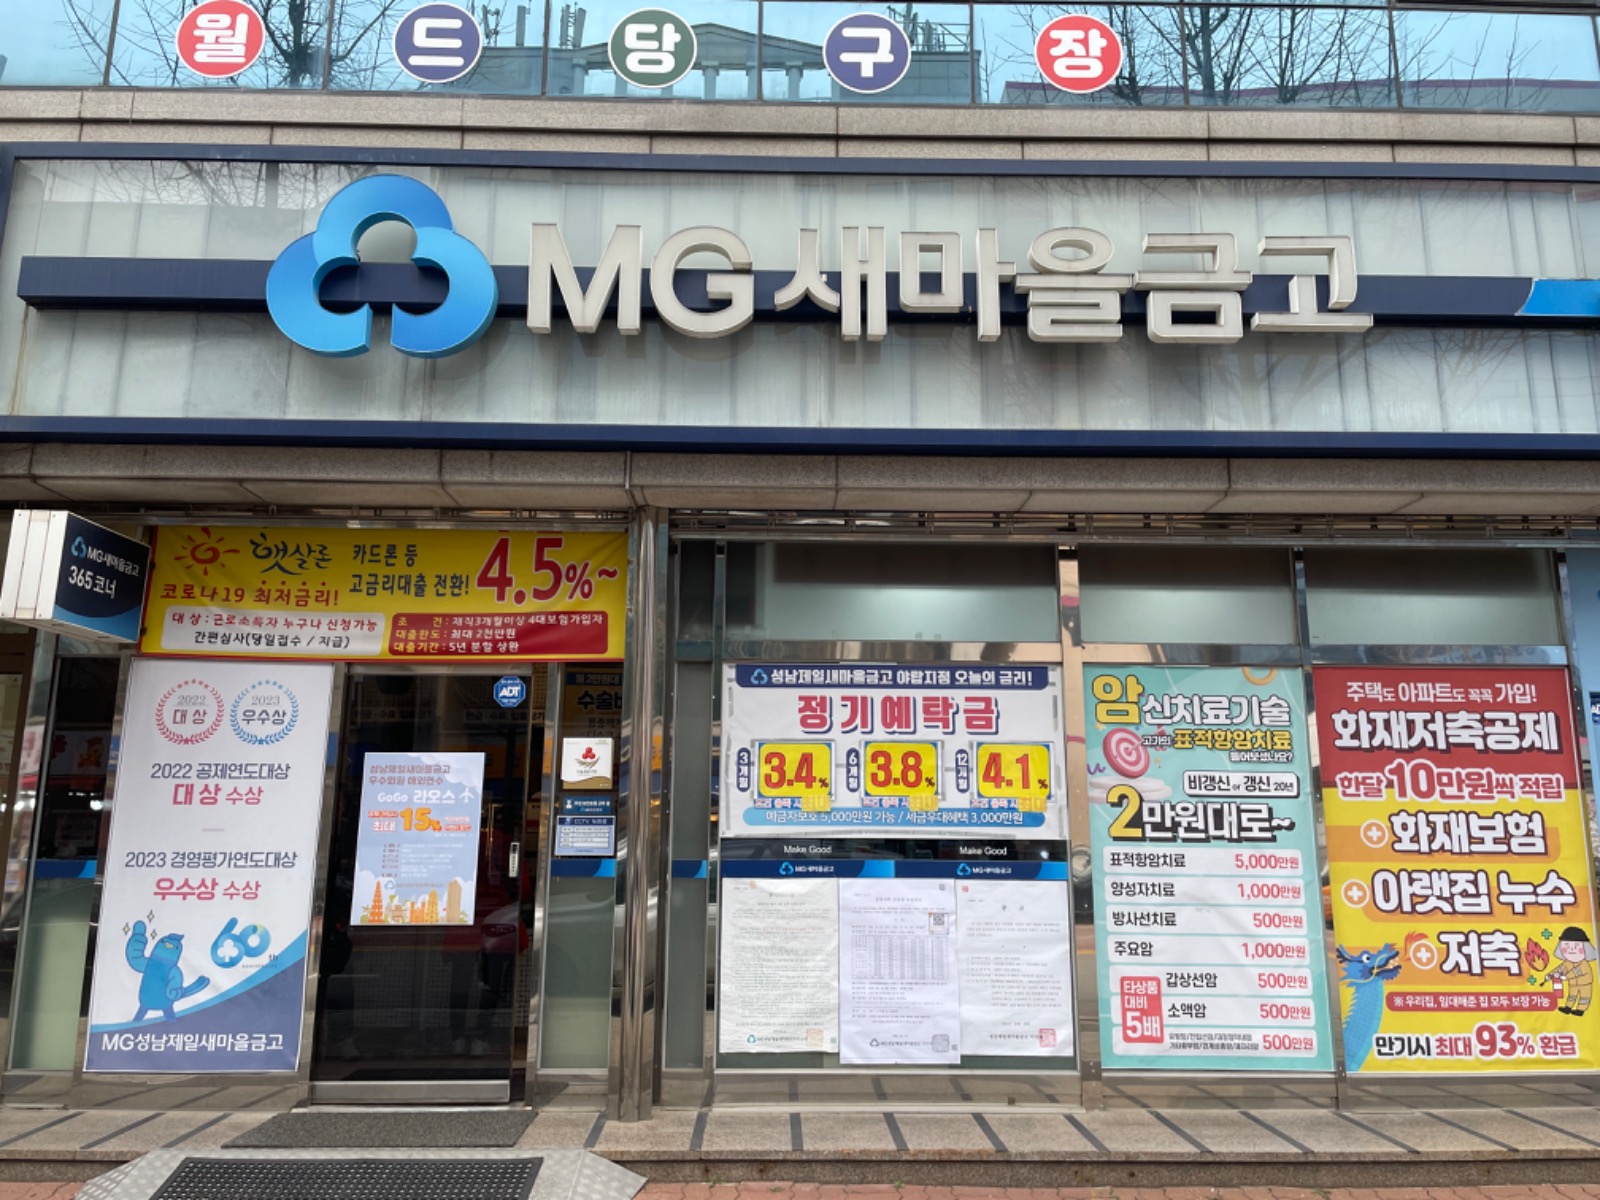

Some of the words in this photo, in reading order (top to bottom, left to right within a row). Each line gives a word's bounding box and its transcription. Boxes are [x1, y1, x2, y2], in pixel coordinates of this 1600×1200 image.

[526, 223, 1374, 345] MG새마을금고
[250, 532, 332, 575] 햇살론
[353, 544, 398, 567] 카드론
[403, 545, 418, 567] 등
[476, 537, 618, 606] 4.5%~
[349, 574, 427, 597] 고금리대출
[433, 574, 469, 597] 전환!
[160, 584, 245, 602] 코로나19
[253, 587, 339, 607] 최저금리!
[283, 618, 322, 631] 누구나
[326, 618, 378, 632] 신청가능
[452, 616, 526, 627] 재직3개월이상
[528, 615, 603, 626] 4대보험가입자
[395, 630, 440, 640] 대출한도
[450, 629, 474, 640] 최대
[476, 629, 516, 640] 2천만원
[393, 643, 438, 653] 대출기간
[449, 642, 467, 653] 5년
[471, 642, 493, 653] 분할
[496, 642, 520, 653] 상환
[771, 668, 892, 686] 성남제일새마을금고
[897, 669, 950, 686] 야탑지점
[955, 669, 995, 686] 오늘의
[999, 670, 1033, 686] 금리!
[178, 695, 207, 705] 2022
[251, 695, 280, 705] 2023
[499, 686, 520, 698] ADT
[1347, 682, 1396, 702] 주택도
[1398, 682, 1466, 703] 아파트도
[1468, 687, 1493, 703] 꼭꼭
[1495, 683, 1536, 704] 가입!
[241, 709, 287, 725] 우수상
[1331, 709, 1560, 752] 화재저축공제
[1142, 734, 1171, 746] 고가의
[1173, 729, 1292, 750] 표적항암치료
[150, 763, 192, 780] 2022
[196, 763, 291, 780] 공제연도대상
[764, 751, 829, 789] 3.4%
[871, 751, 935, 789] 3.8%
[982, 752, 1048, 790] 4.1%
[1188, 775, 1231, 791] 비갱신
[1243, 775, 1271, 791] 갱신
[1274, 782, 1294, 792] 20년
[1338, 772, 1386, 800] 한달
[1518, 774, 1565, 802] 적립
[225, 786, 264, 805] 수상
[377, 791, 409, 803] GoGo
[413, 789, 455, 804] 라오스
[766, 810, 817, 824] 예금자보호
[820, 810, 873, 825] 5,000만원
[875, 811, 896, 824] 가능
[906, 810, 969, 825] 세금우대혜택
[971, 811, 1023, 825] 3,000만원
[1389, 809, 1547, 855] 화재보험
[783, 844, 807, 854] Make
[809, 844, 832, 854] Good
[959, 846, 982, 855] Make
[984, 845, 1007, 855] Good
[125, 851, 166, 868] 2023
[171, 851, 297, 869] 경영평가연도대상
[1110, 853, 1186, 868] 표적항암치료
[1235, 853, 1299, 871] 5,000만원
[153, 878, 219, 901] 우수상
[222, 880, 262, 900] 수상
[1111, 882, 1176, 898] 양성자치료
[1238, 883, 1301, 900] 1,000만원
[1371, 869, 1492, 914] 아랫집
[1497, 869, 1576, 915] 누수
[1112, 911, 1177, 927] 방사선치료
[1253, 913, 1303, 929] 500만원
[1114, 941, 1153, 956] 주요암
[1241, 943, 1306, 960] 1,000만원
[1437, 930, 1521, 977] 저축
[1123, 981, 1158, 995] 타상품
[1165, 973, 1217, 988] 갑상선암
[1257, 973, 1308, 989] 500만원
[1124, 995, 1147, 1009] 대비
[1406, 995, 1437, 1008] 우리집,
[1439, 995, 1477, 1008] 임대해준
[1479, 995, 1488, 1008] 집
[1490, 995, 1509, 1008] 모두
[1512, 995, 1529, 1007] 보장
[1531, 995, 1550, 1007] 가능
[1167, 1003, 1207, 1019] 소액암
[1259, 1004, 1311, 1020] 500만원
[1126, 1012, 1161, 1038] 5배
[102, 1033, 284, 1053] MG성남제일새마을금고
[1262, 1034, 1314, 1051] 500만원
[1375, 1035, 1431, 1056] 만기시
[1435, 1035, 1472, 1057] 최대
[1476, 1024, 1535, 1057] 93%
[1540, 1034, 1576, 1057] 환급
